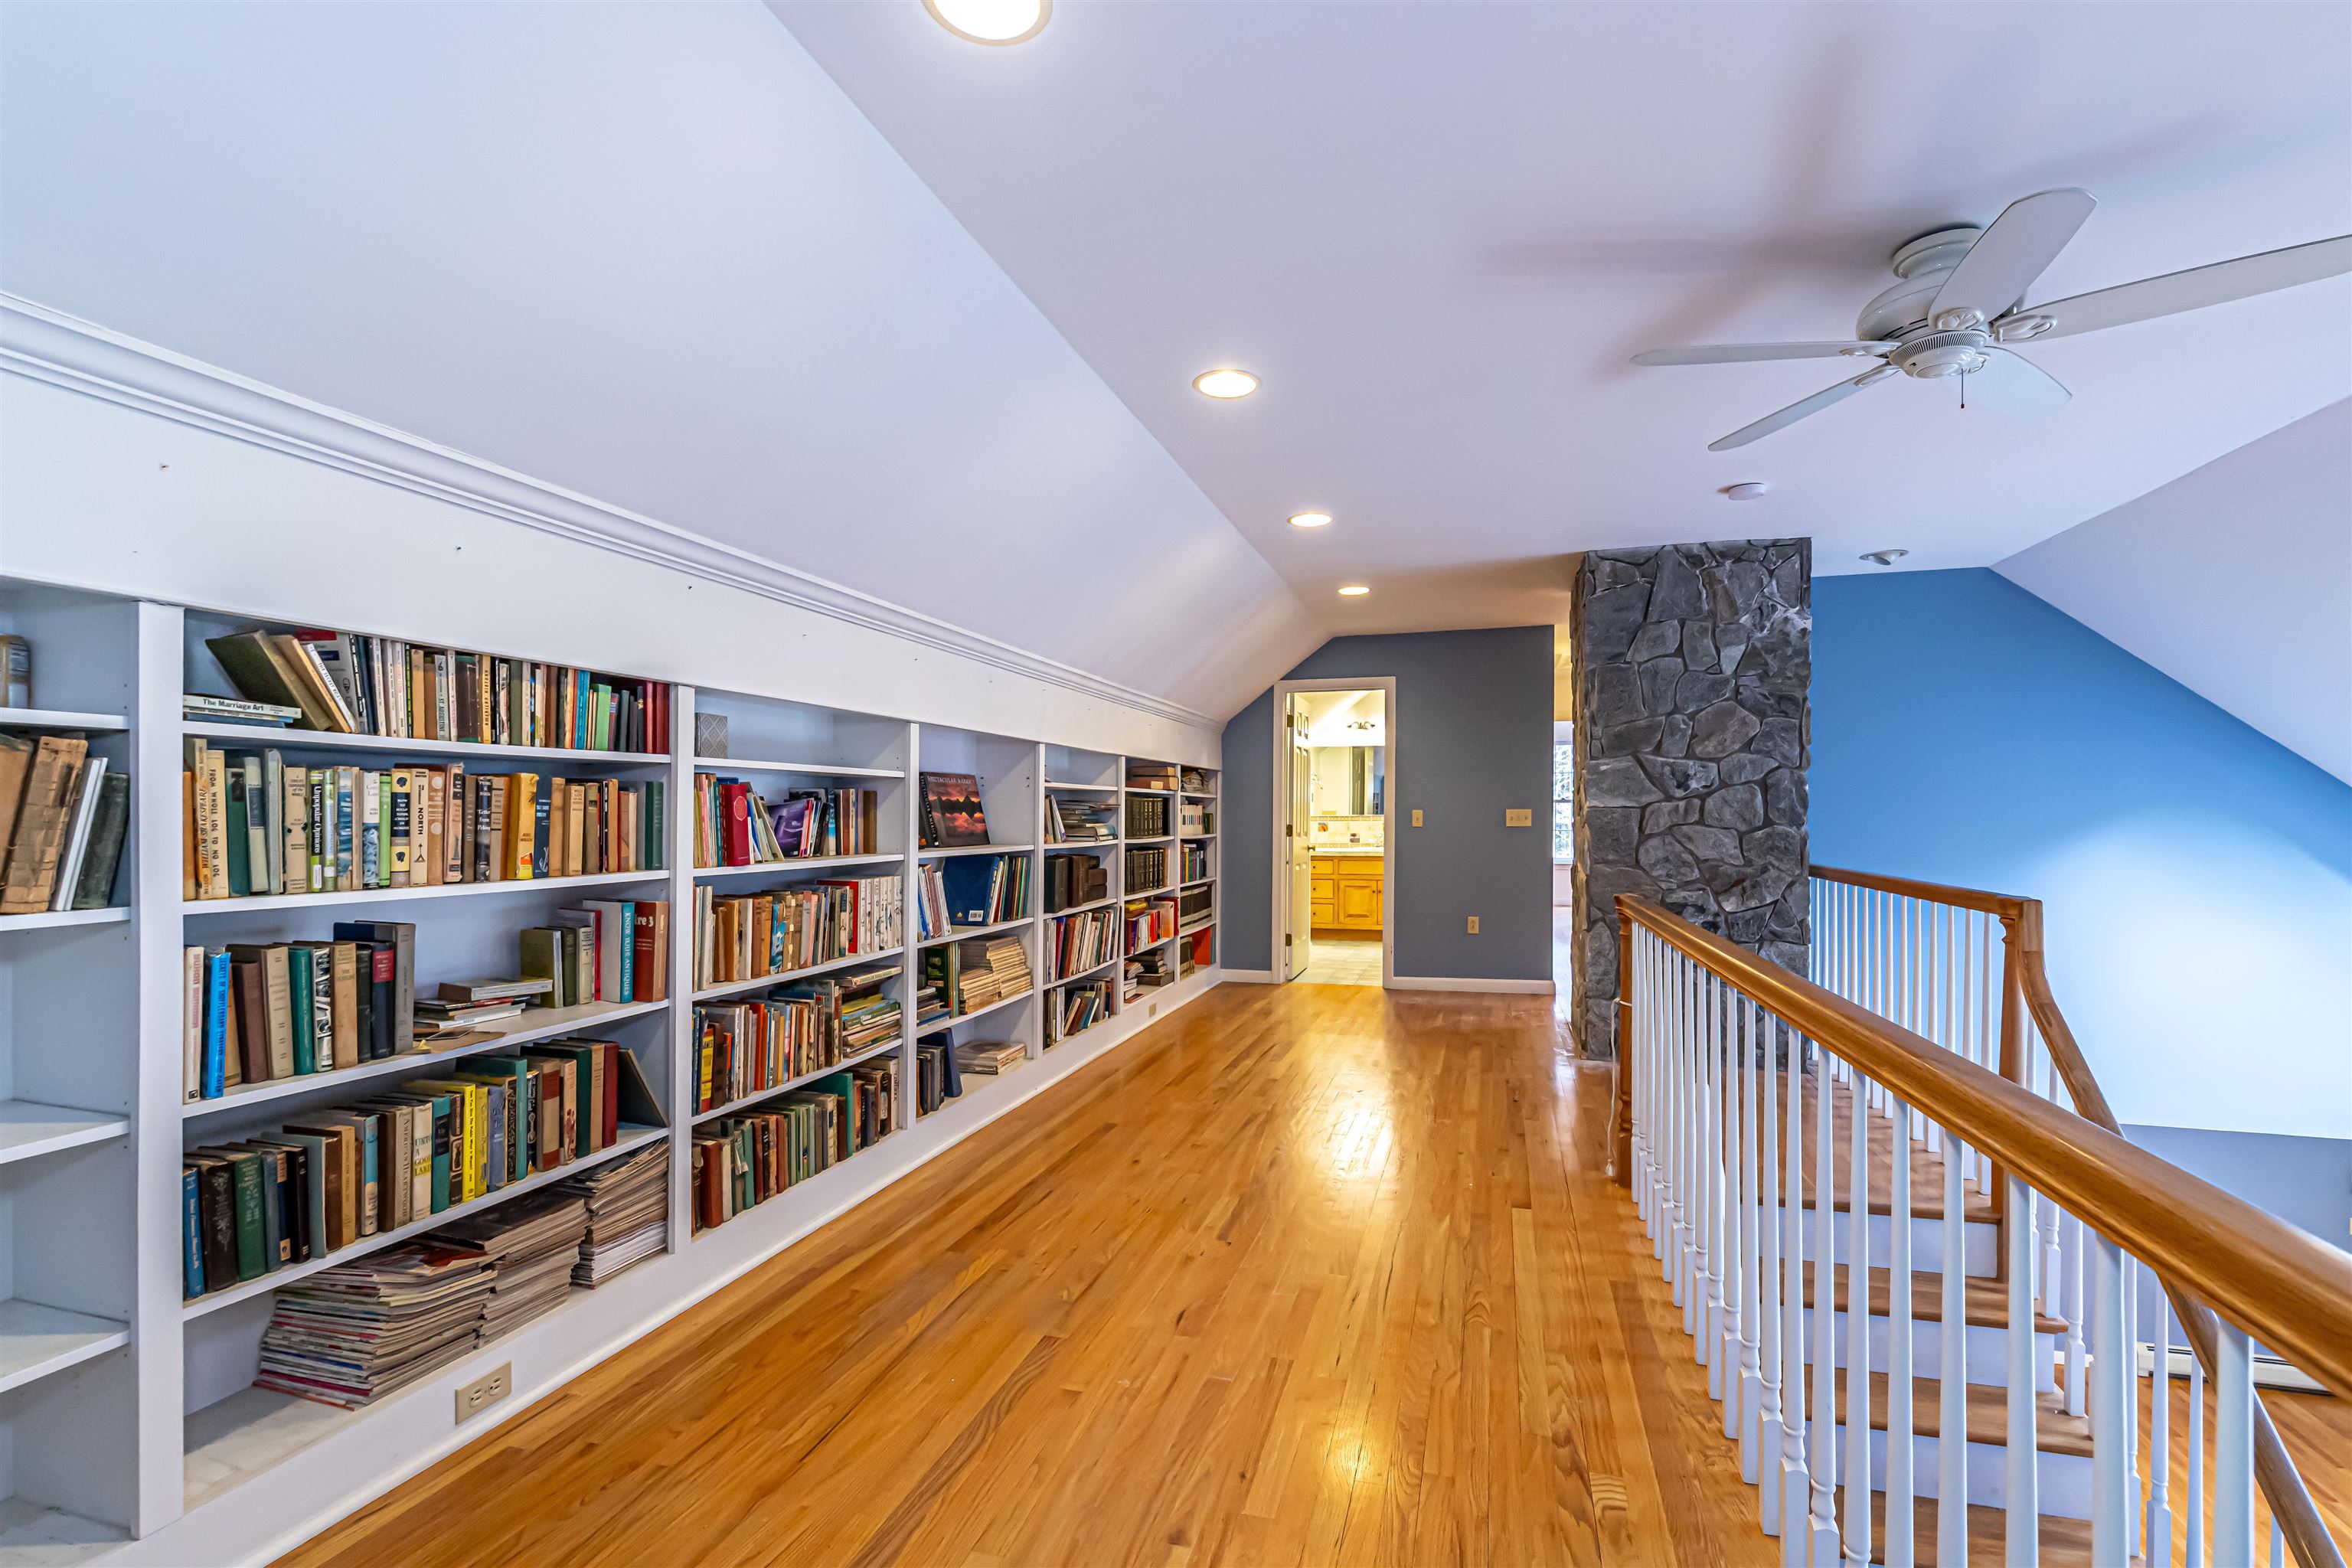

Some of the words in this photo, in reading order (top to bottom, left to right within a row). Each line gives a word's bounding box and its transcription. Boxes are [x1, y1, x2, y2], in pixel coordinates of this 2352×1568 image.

[322, 673, 334, 690] SECRET
[203, 698, 217, 707] The
[218, 700, 251, 711] Marriage
[253, 704, 265, 712] Art
[209, 769, 217, 788] FROM
[211, 791, 219, 815] WHOLE
[312, 785, 322, 822] Unpopular
[920, 776, 931, 812] SPECTACULAR
[198, 789, 208, 837] SHAKESPEARE
[212, 836, 219, 845] TO
[312, 822, 322, 854] Opinions
[201, 838, 209, 870] WILLIAM
[213, 848, 220, 860] NO
[648, 916, 654, 927] 3
[623, 958, 632, 995] ANTIQUES
